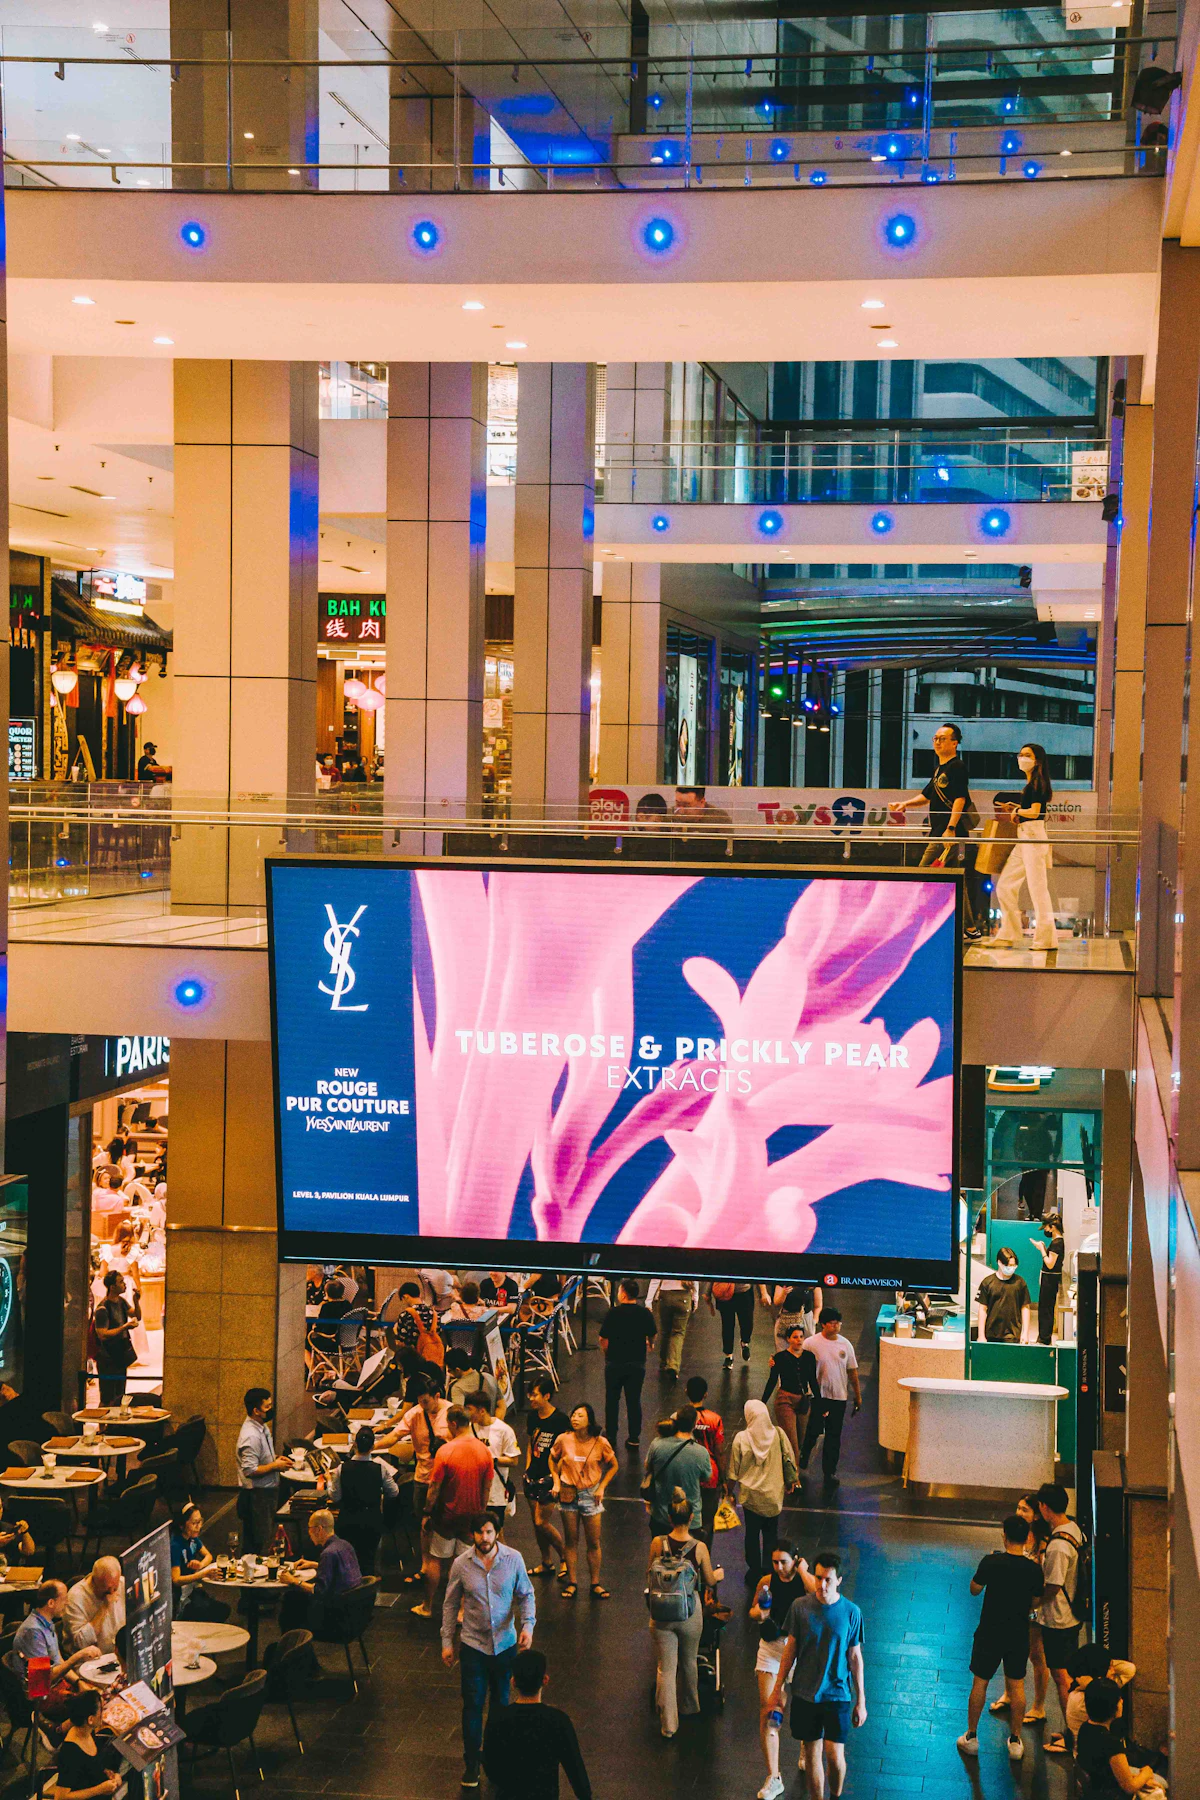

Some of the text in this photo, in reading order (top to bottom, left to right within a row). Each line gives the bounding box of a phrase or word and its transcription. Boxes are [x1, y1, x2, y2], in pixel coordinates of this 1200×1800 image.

[327, 599, 361, 616] BAH
[590, 797, 624, 815] play
[318, 903, 370, 1012] YSL
[116, 1035, 170, 1077] PARIS
[455, 1030, 910, 1069] TUBEROSE & PRICKLY PEAR
[334, 1067, 359, 1078] NEW
[606, 1065, 752, 1094] EXTRACTS
[316, 1080, 378, 1097] ROUGE
[286, 1096, 410, 1115] PUR COUTURE
[292, 1191, 314, 1199] LEVEL
[322, 1192, 355, 1200] PAVILION
[355, 1193, 380, 1201] KUALA
[380, 1194, 410, 1203] LUMPUR
